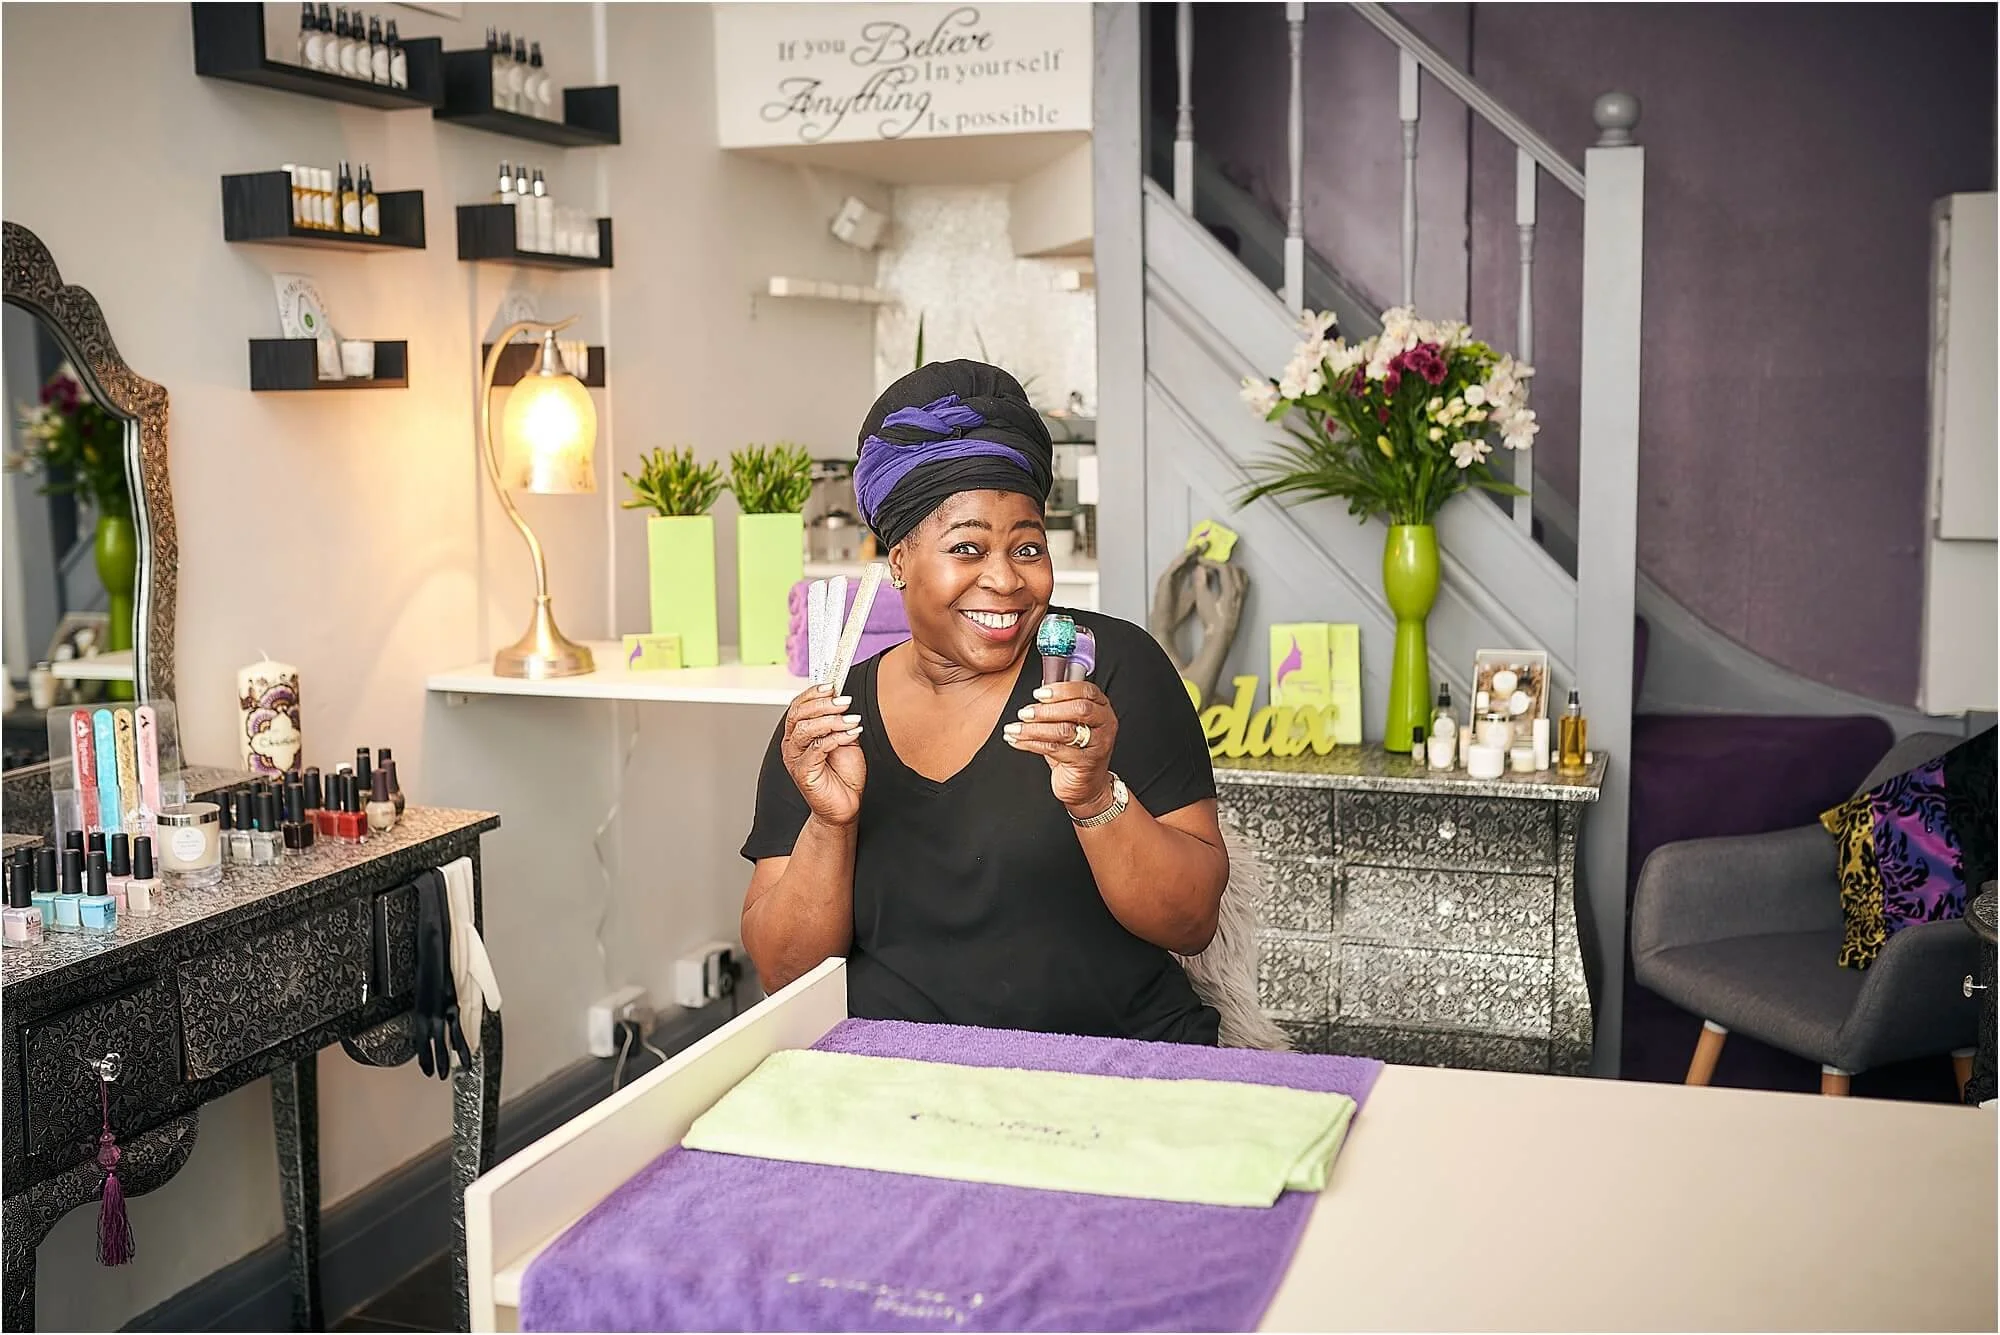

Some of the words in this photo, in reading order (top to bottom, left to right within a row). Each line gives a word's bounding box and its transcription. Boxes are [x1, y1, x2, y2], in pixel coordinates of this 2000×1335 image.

[777, 41, 795, 61] If
[802, 39, 846, 60] you
[850, 7, 993, 67] Believe
[925, 61, 949, 81] In
[955, 48, 1063, 84] yourself
[760, 64, 932, 143] Anything
[928, 113, 949, 132] Is
[956, 104, 1059, 134] possible
[1184, 677, 1340, 758] elax
